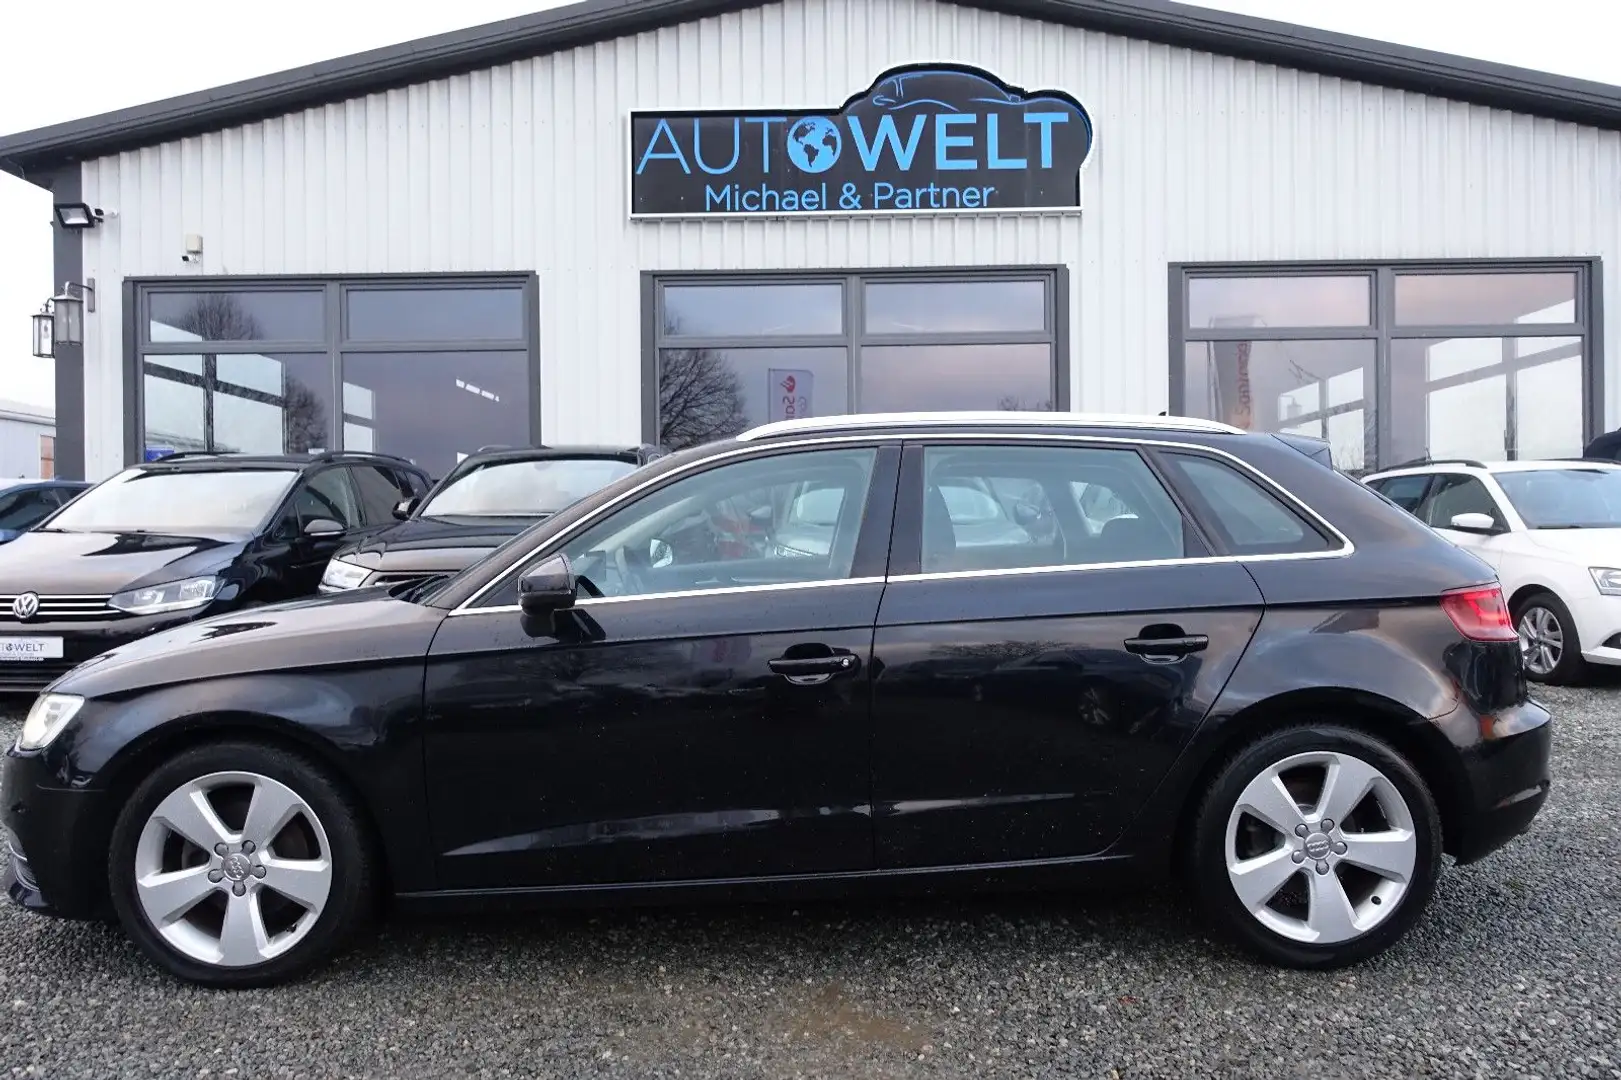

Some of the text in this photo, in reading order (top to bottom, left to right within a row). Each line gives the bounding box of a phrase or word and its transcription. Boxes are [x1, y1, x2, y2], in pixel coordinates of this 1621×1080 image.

[706, 182, 995, 211] Michael & Partner
